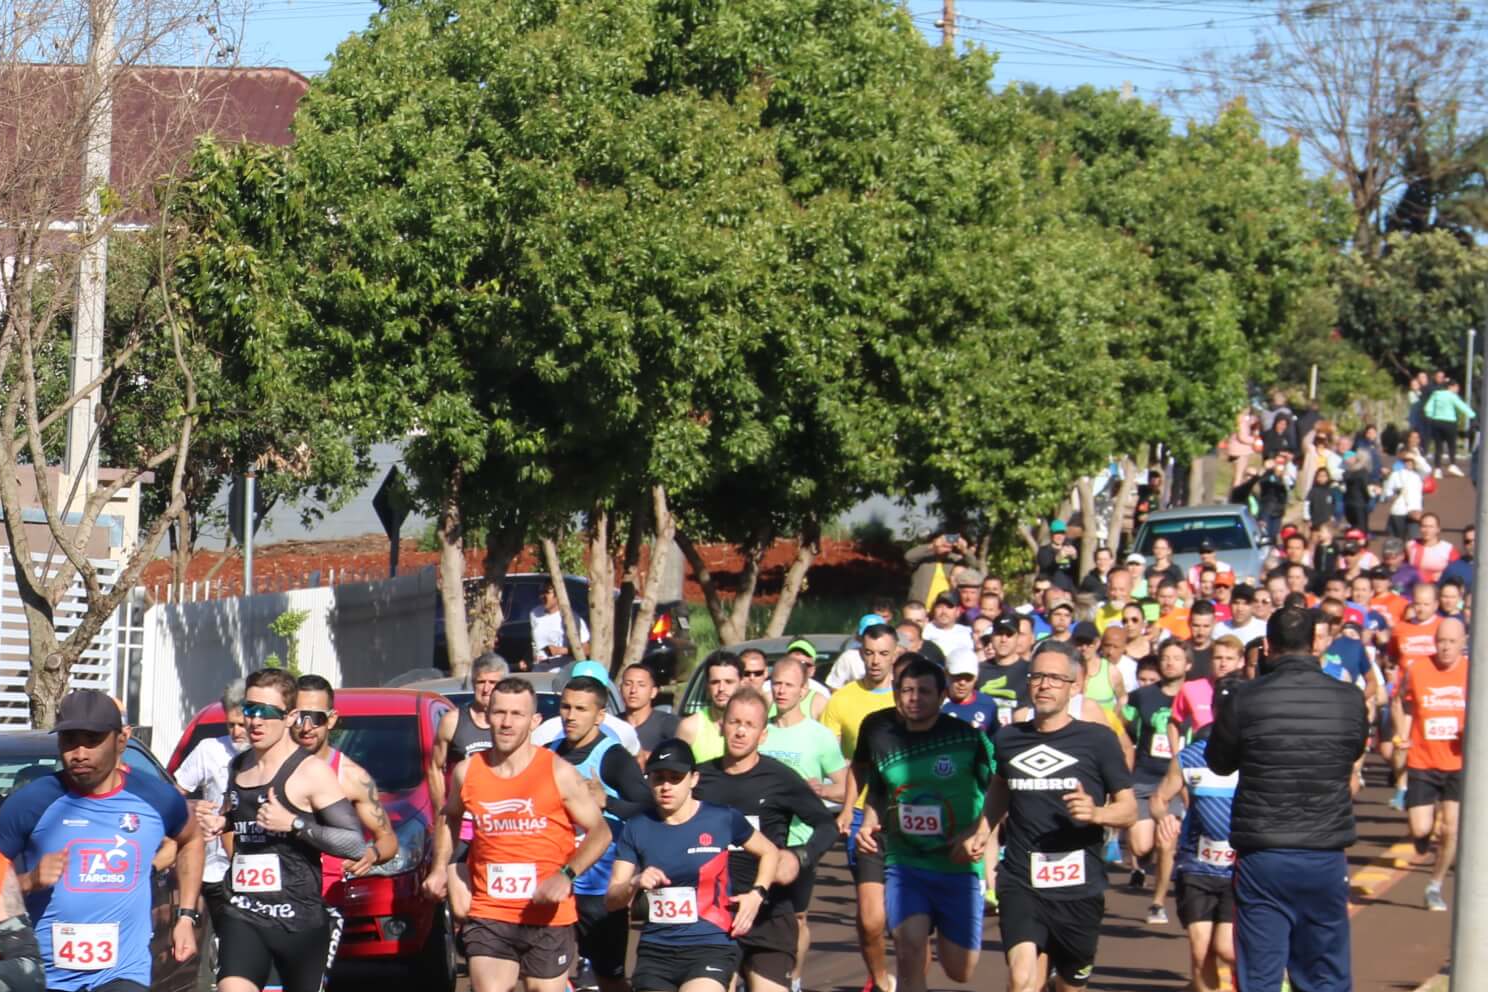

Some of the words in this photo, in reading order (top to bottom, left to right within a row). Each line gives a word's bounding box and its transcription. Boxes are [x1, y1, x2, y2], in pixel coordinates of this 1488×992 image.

[903, 815, 938, 831] 329
[79, 849, 129, 874] TAG
[1201, 848, 1236, 862] 479
[79, 873, 125, 883] TARCISO
[235, 868, 276, 887] 426
[1036, 864, 1081, 882] 452
[491, 876, 532, 894] 437
[653, 900, 693, 918] 334
[58, 940, 113, 963] 433
